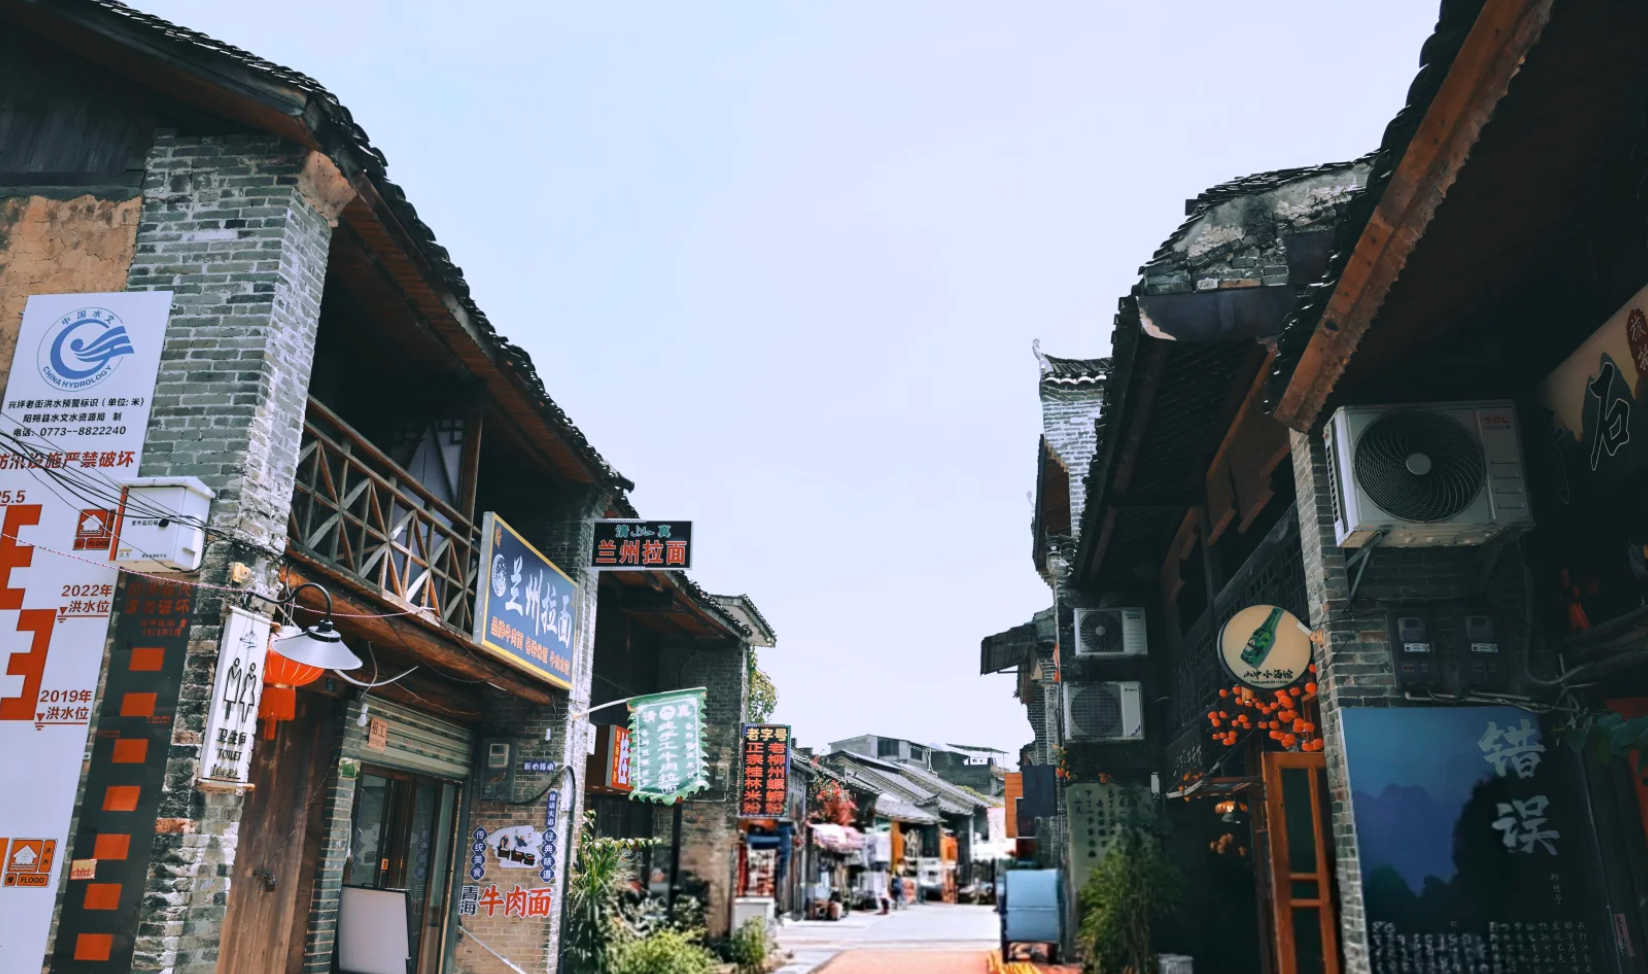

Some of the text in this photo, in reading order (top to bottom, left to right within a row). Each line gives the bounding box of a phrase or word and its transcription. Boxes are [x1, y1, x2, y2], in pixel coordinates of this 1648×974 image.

[61, 309, 116, 326] 中国水文
[42, 365, 112, 389] CHINA HYDROLOGY
[22, 412, 122, 424] 阳朔县水文水资源局 制
[1484, 416, 1508, 424] TCL
[0, 490, 26, 504] 5.5
[615, 524, 630, 538] 清
[657, 524, 672, 539] 真
[596, 539, 688, 566] 兰州拉面
[61, 584, 114, 598] 2022年
[68, 599, 110, 614] 洪水位
[505, 555, 573, 649] 兰州拉面
[39, 689, 93, 704] 2019年
[45, 706, 89, 721] 洪水位
[216, 727, 247, 746] 卫生间
[746, 728, 788, 741] 老字号
[217, 748, 242, 761] TOILET
[743, 742, 764, 814] 正宗桂林米粉
[765, 742, 786, 814] 老柳州螺蛳粉
[1477, 718, 1562, 856] 错误
[472, 830, 486, 878] 传统美食
[541, 832, 555, 880] 经典味道
[20, 876, 45, 884] FLOOD
[459, 885, 480, 916] 青海
[479, 884, 554, 918] 牛肉面
